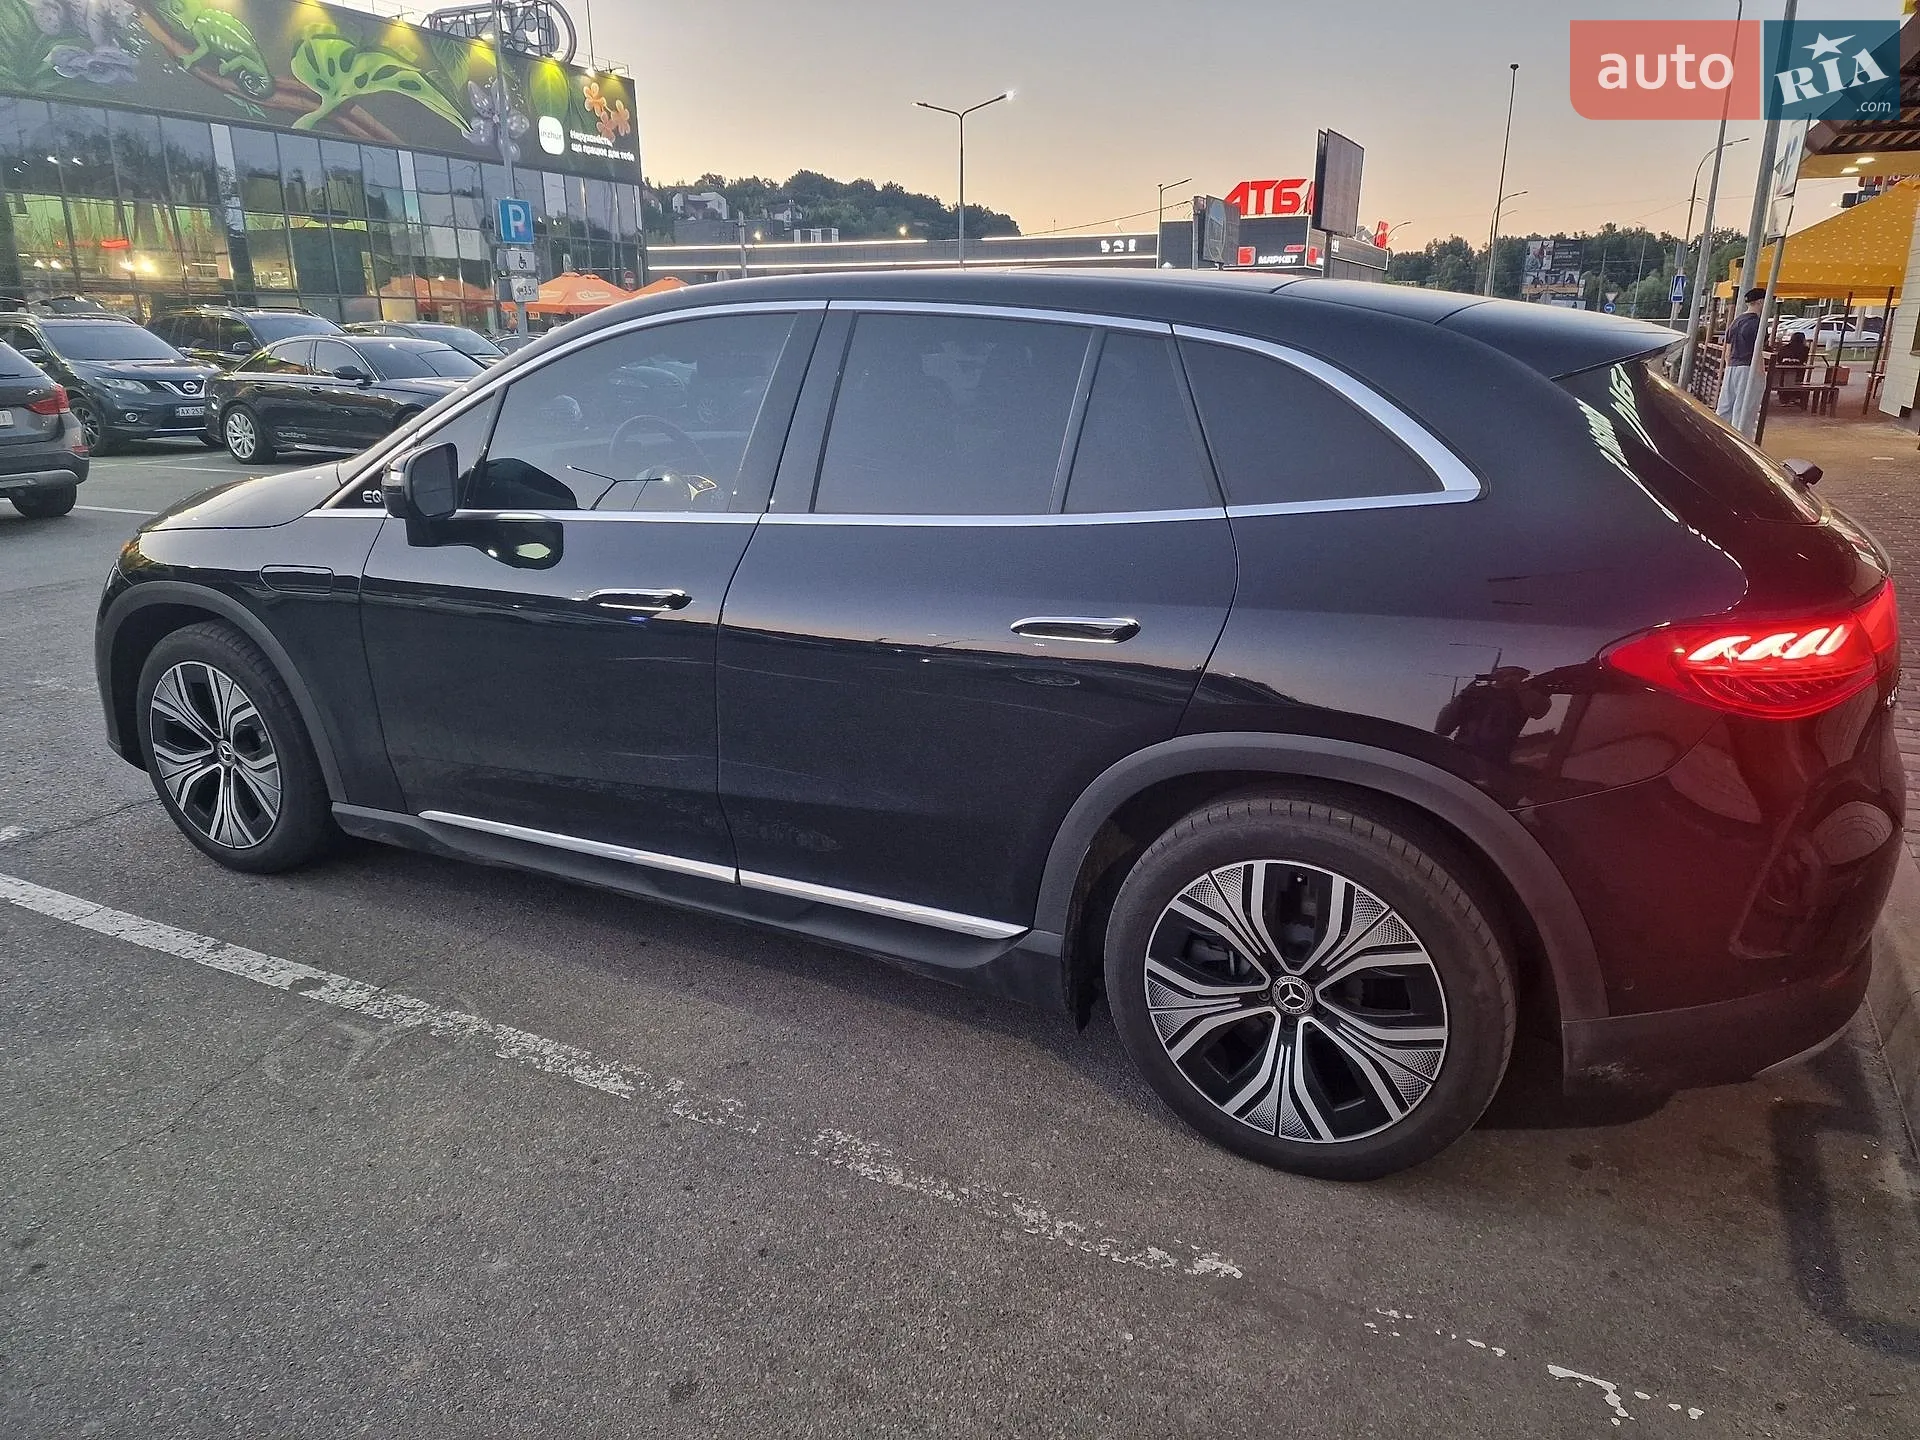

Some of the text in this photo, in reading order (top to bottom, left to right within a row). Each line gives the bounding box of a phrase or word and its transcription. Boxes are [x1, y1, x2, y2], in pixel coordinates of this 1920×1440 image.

[1224, 178, 1307, 215] АТБ
[508, 204, 525, 239] P
[1258, 255, 1298, 264] МАРКЕТ
